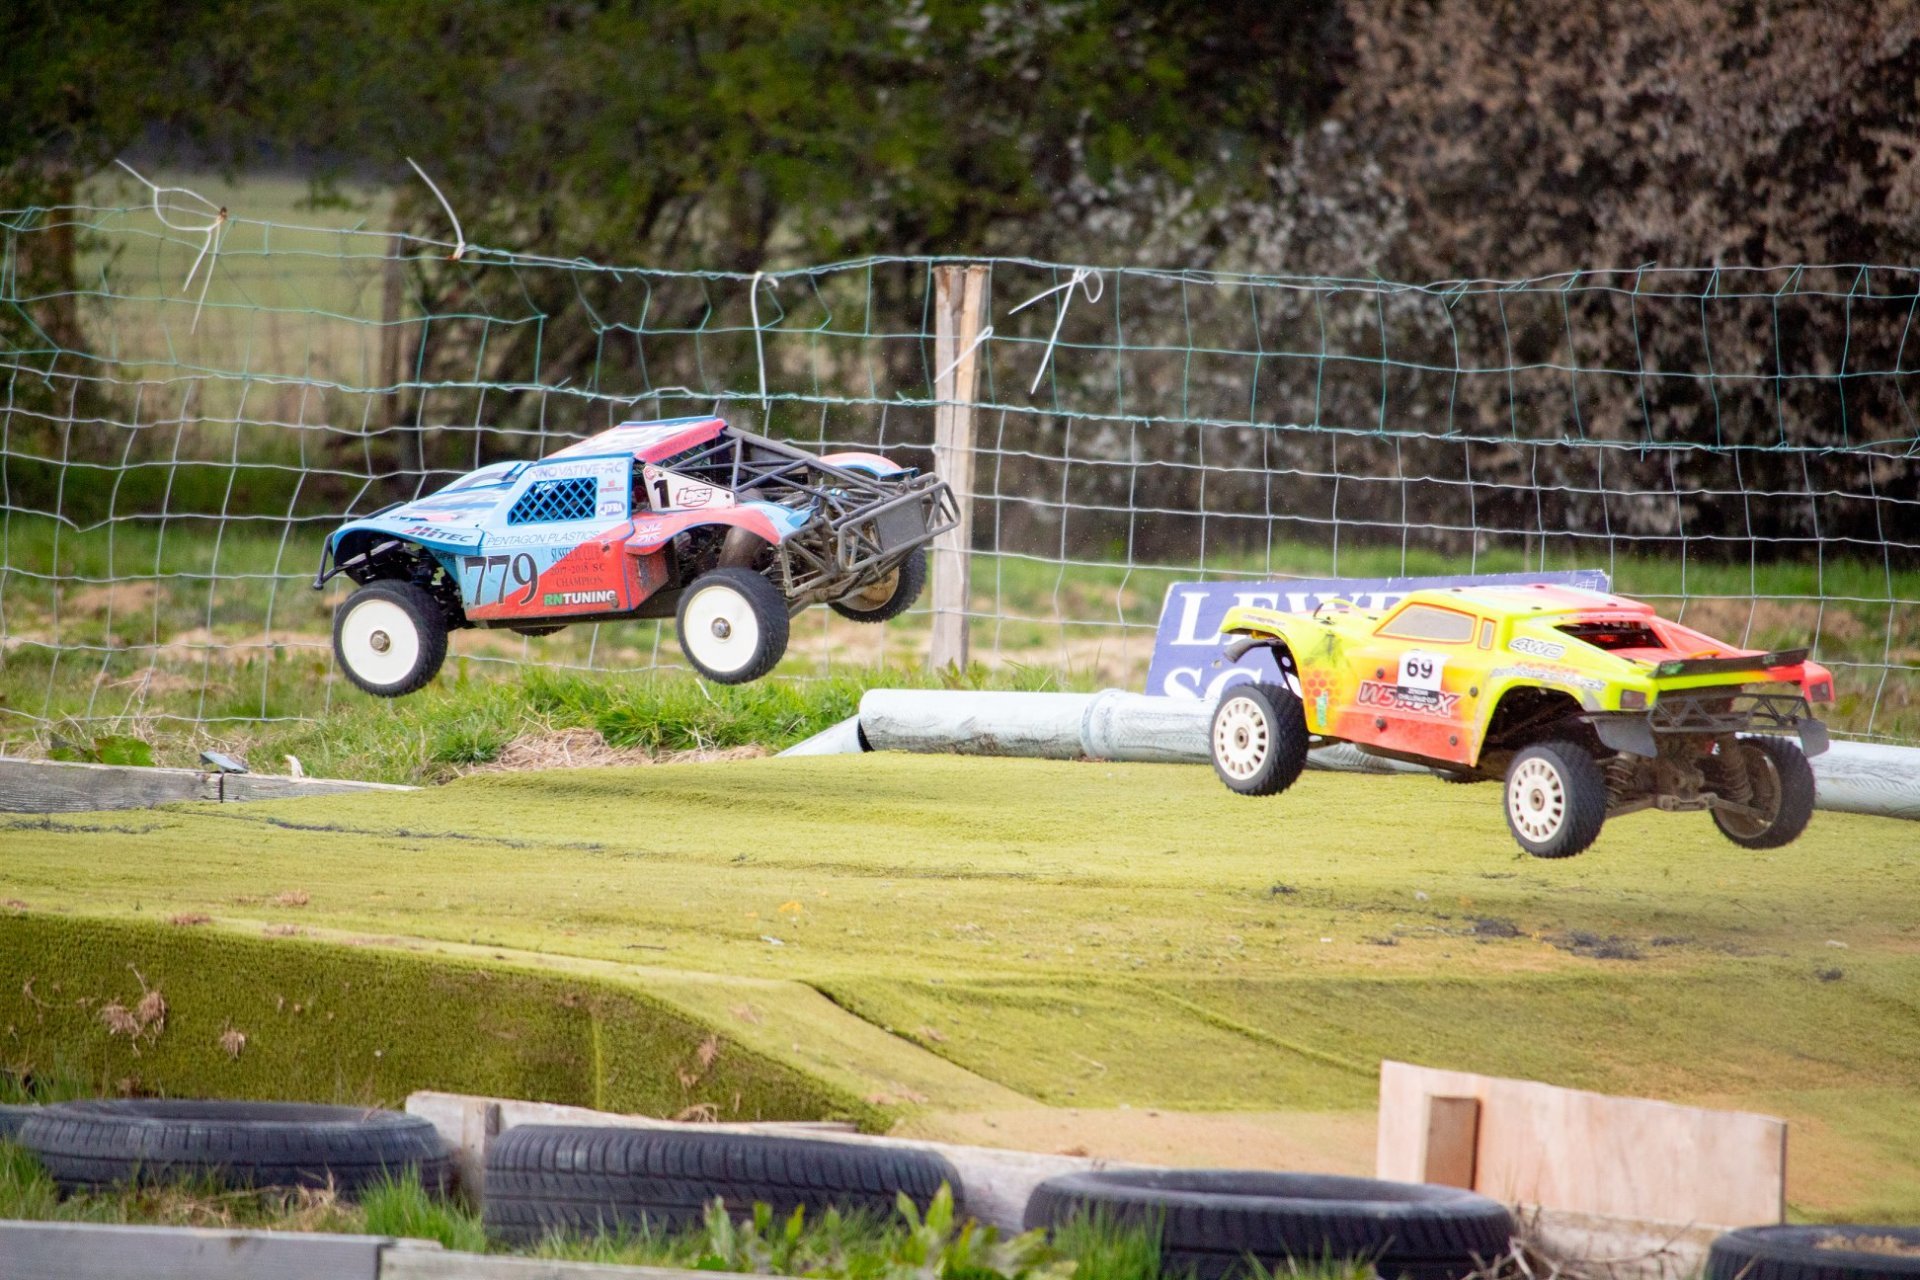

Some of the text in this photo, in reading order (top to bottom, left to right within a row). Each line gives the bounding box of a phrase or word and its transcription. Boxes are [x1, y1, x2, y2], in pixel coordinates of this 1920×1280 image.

[654, 479, 670, 508] 1
[487, 531, 600, 546] PENTAGON PLASTICS
[464, 552, 539, 607] 779
[1510, 637, 1565, 659] 4WD
[1406, 657, 1433, 679] 69
